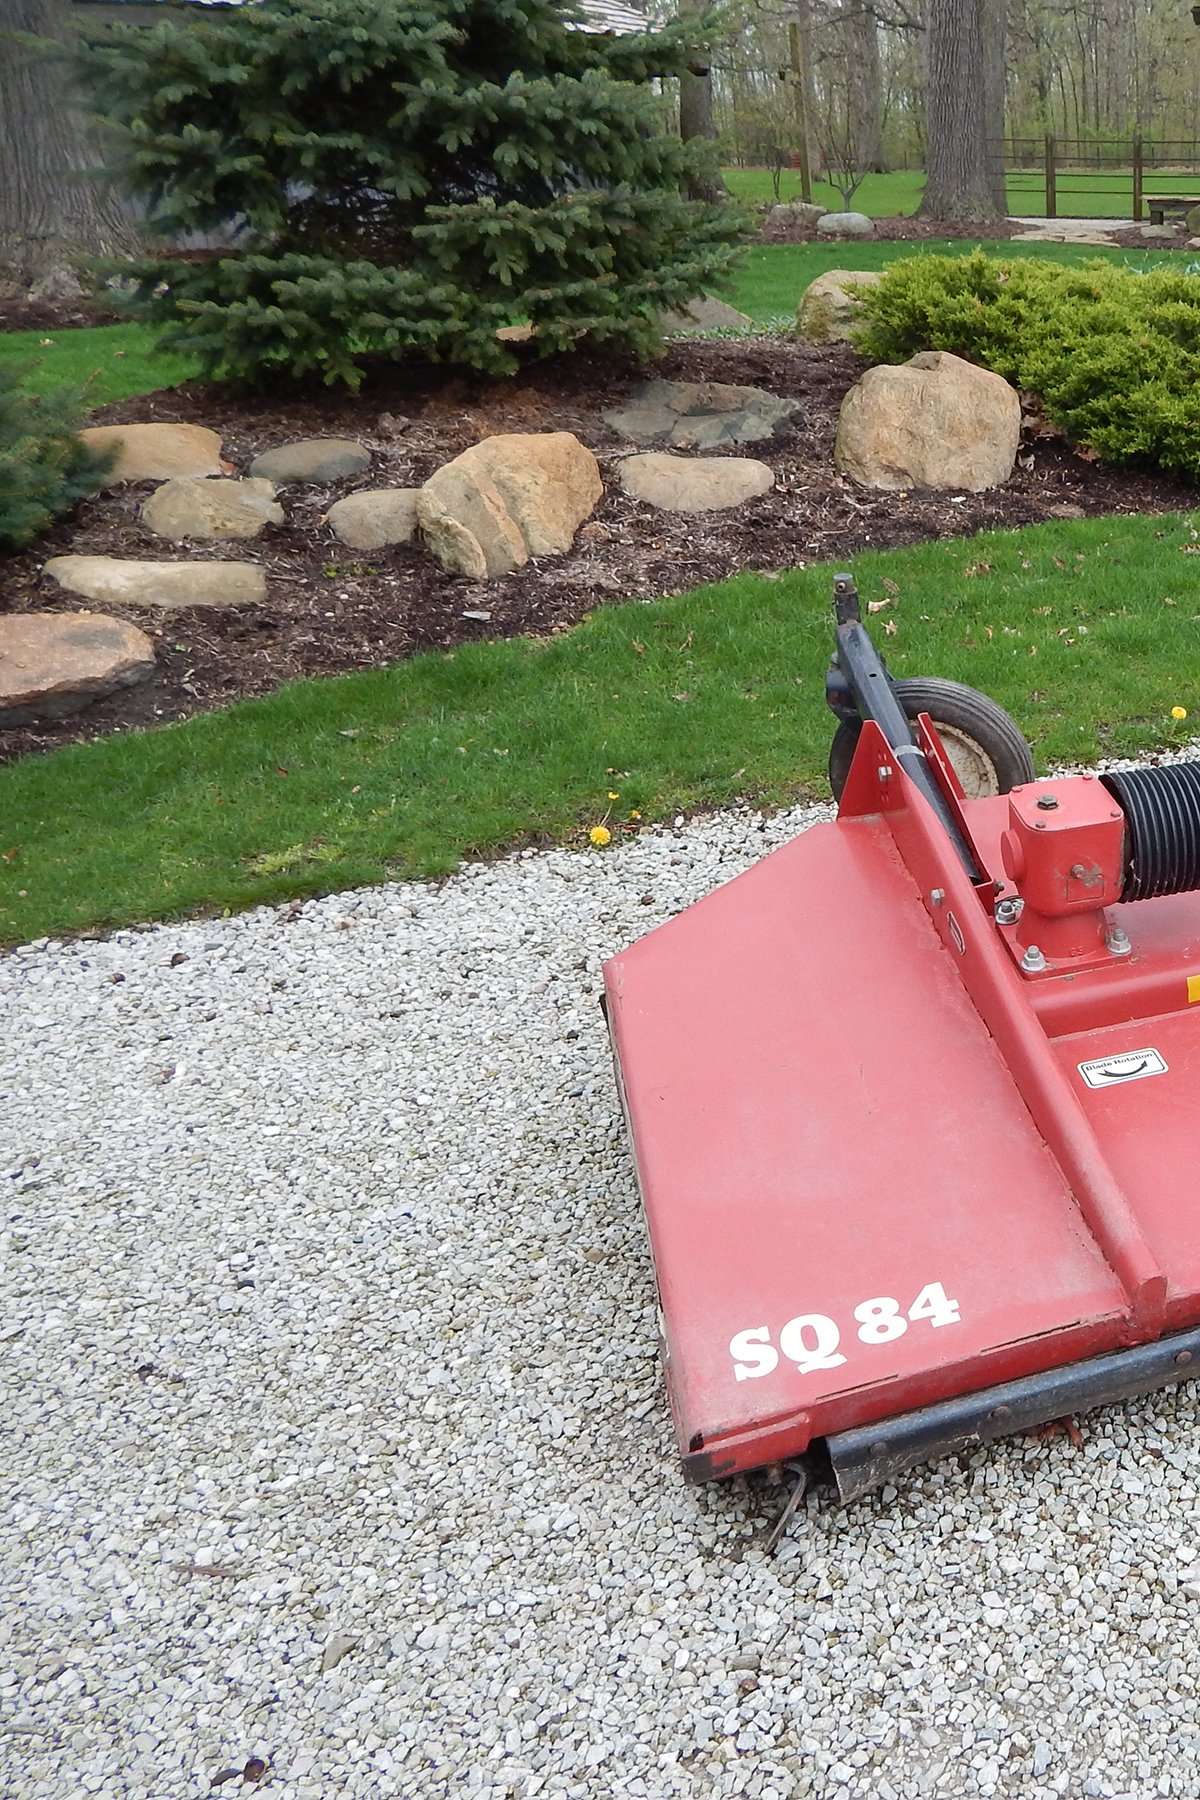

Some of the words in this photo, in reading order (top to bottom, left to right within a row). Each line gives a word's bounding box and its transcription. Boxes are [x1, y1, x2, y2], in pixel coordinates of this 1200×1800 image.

[1085, 1061, 1113, 1071] Blade
[1113, 1053, 1153, 1065] Rotation
[728, 1313, 848, 1382] SQ
[853, 1281, 961, 1345] 84
